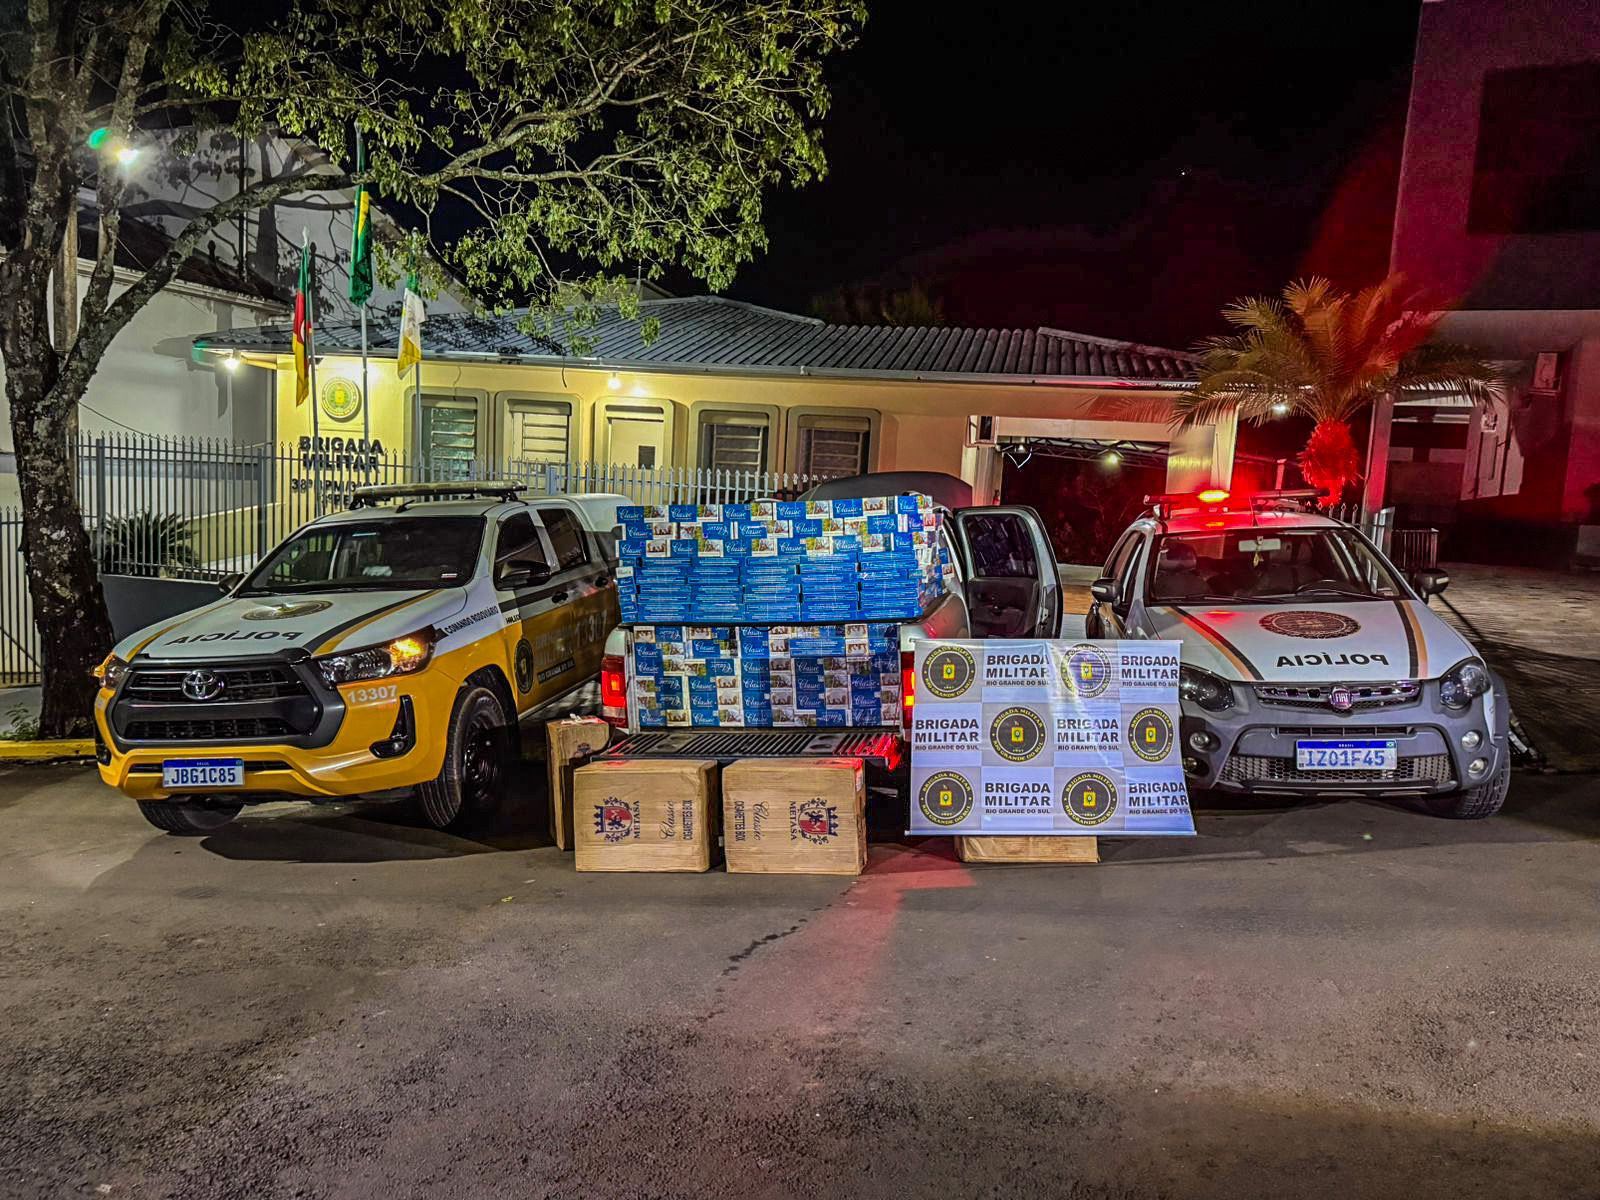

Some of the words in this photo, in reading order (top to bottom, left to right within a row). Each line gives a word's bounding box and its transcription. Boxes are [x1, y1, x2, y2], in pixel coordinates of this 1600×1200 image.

[300, 436, 384, 456] BRIGADA
[303, 454, 380, 471] MILITAR
[1122, 656, 1178, 666] BRIGADA
[1122, 669, 1178, 678] MILITAR
[348, 685, 398, 703] 13307
[916, 719, 979, 730] BRIGADA
[994, 708, 1018, 728] BRIGADA
[1020, 709, 1042, 728] MILITAR
[1057, 719, 1119, 730] BRIGADA
[915, 732, 979, 742] MILITAR
[1058, 732, 1118, 742] MILITAR
[171, 768, 236, 784] JBG1C85
[948, 772, 970, 792] MILITAR
[984, 782, 1050, 793] BRIGADA
[1129, 782, 1186, 793] BRIGADA
[984, 796, 1050, 806] MILITAR
[1129, 796, 1188, 806] MILITAR
[660, 800, 676, 839] Classic
[734, 801, 745, 830] CIGARETTES
[752, 801, 769, 840] Classic
[789, 801, 798, 840] METASA
